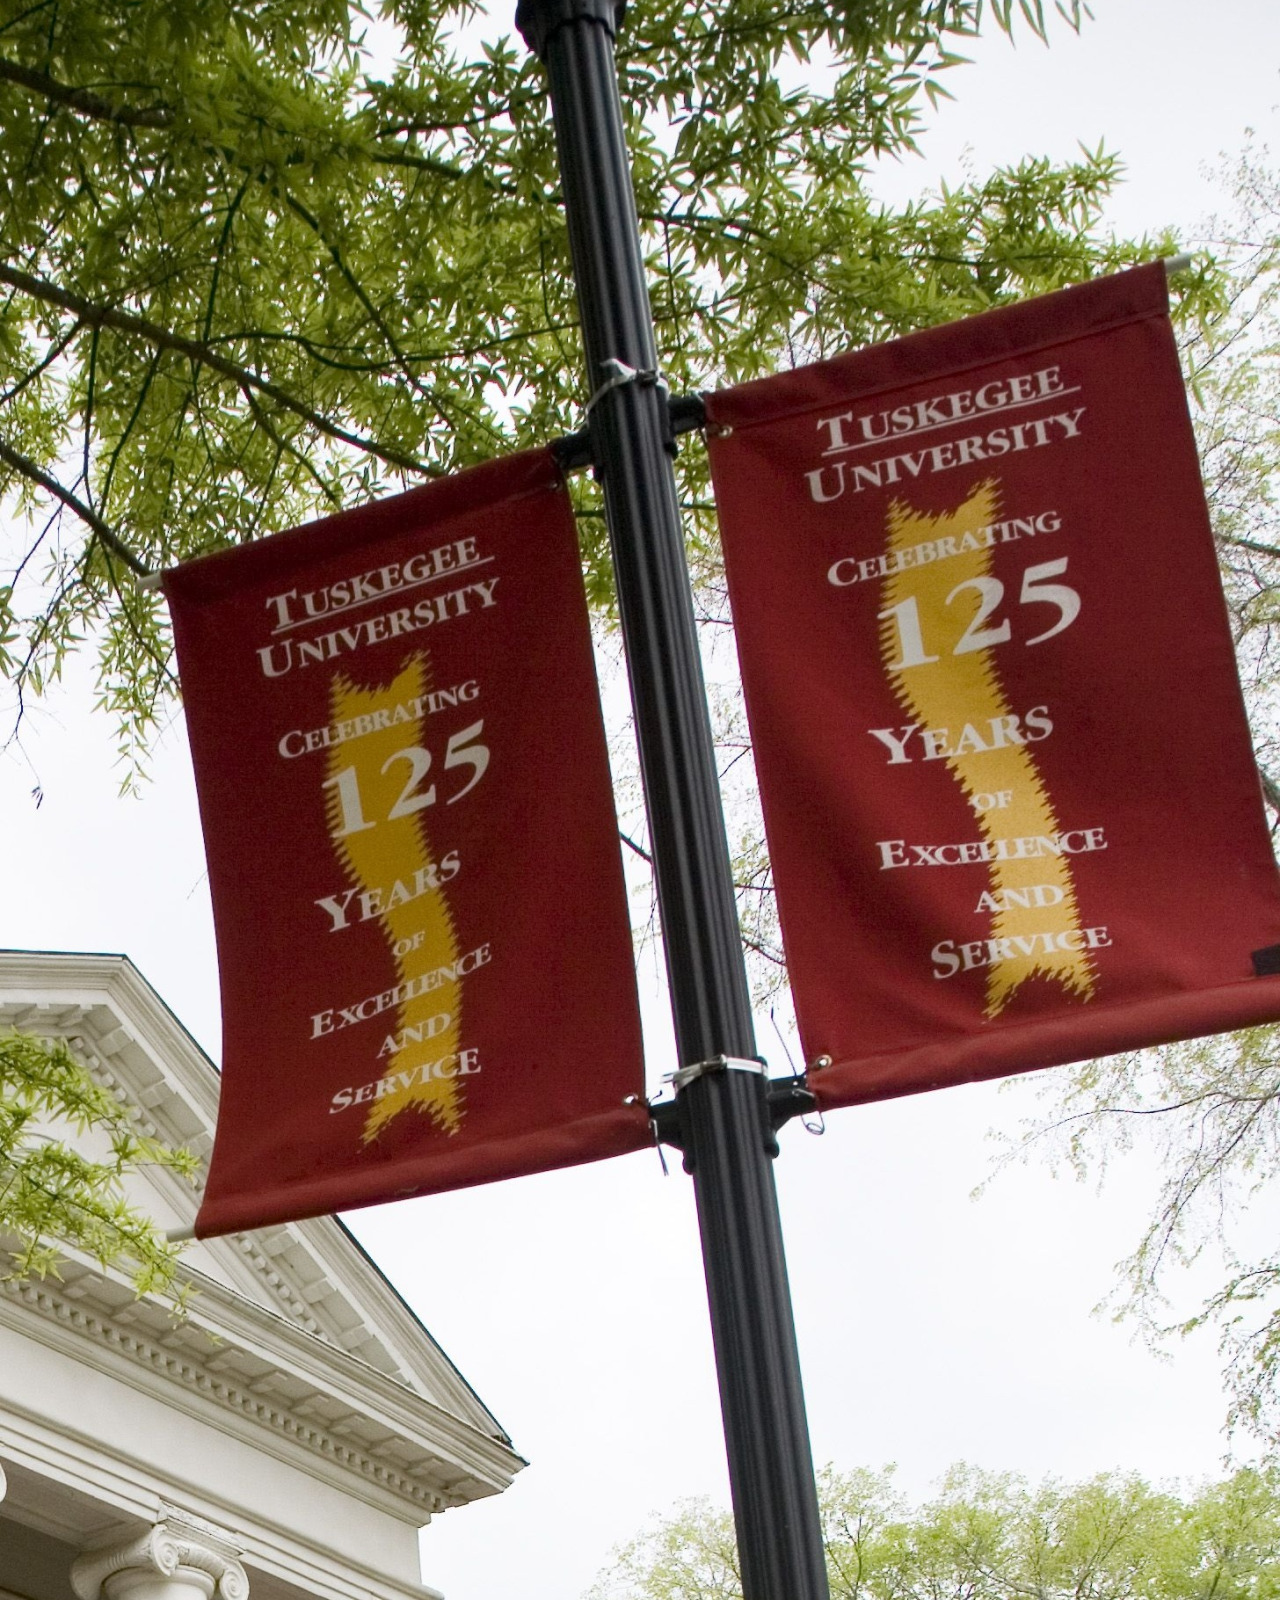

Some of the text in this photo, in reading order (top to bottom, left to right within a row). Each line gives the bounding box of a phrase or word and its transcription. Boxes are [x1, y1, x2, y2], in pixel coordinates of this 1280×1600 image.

[816, 366, 1064, 453] TUSKEGEE
[805, 407, 1086, 504] UNIVERSITY
[266, 536, 480, 628] TUSKEGEE
[827, 511, 1062, 589] CELEBRATING
[257, 578, 499, 679] UNIVERSITY
[877, 557, 1082, 673] 125
[278, 681, 480, 759] CELEBRATING
[868, 706, 1053, 766] YEARS
[321, 719, 491, 837] 125
[974, 790, 1013, 812] OF
[876, 827, 1108, 869] EXCELLENCE
[314, 851, 461, 932] YEARS
[975, 884, 1064, 914] AND
[393, 931, 426, 958] OF
[931, 926, 1111, 979] SERVICE
[309, 944, 493, 1039] EXCELLENCE
[377, 1013, 451, 1058] AND
[329, 1048, 481, 1114] SERVICE
